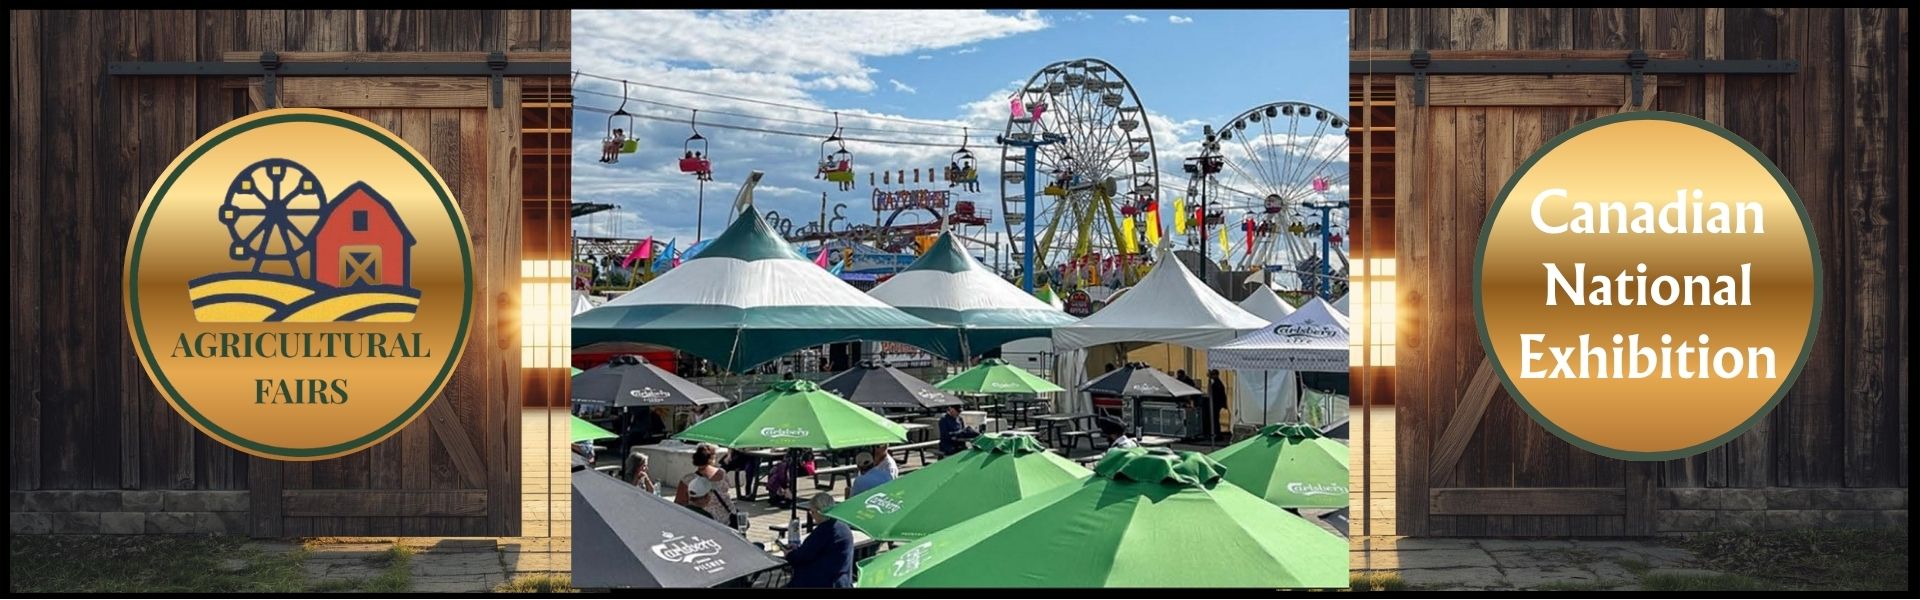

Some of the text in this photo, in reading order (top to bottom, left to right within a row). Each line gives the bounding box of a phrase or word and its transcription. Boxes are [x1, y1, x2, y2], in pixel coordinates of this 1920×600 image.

[1273, 324, 1337, 339] Carlsberg
[761, 427, 809, 438] Carlsberg
[651, 536, 722, 563] Carlsberg
